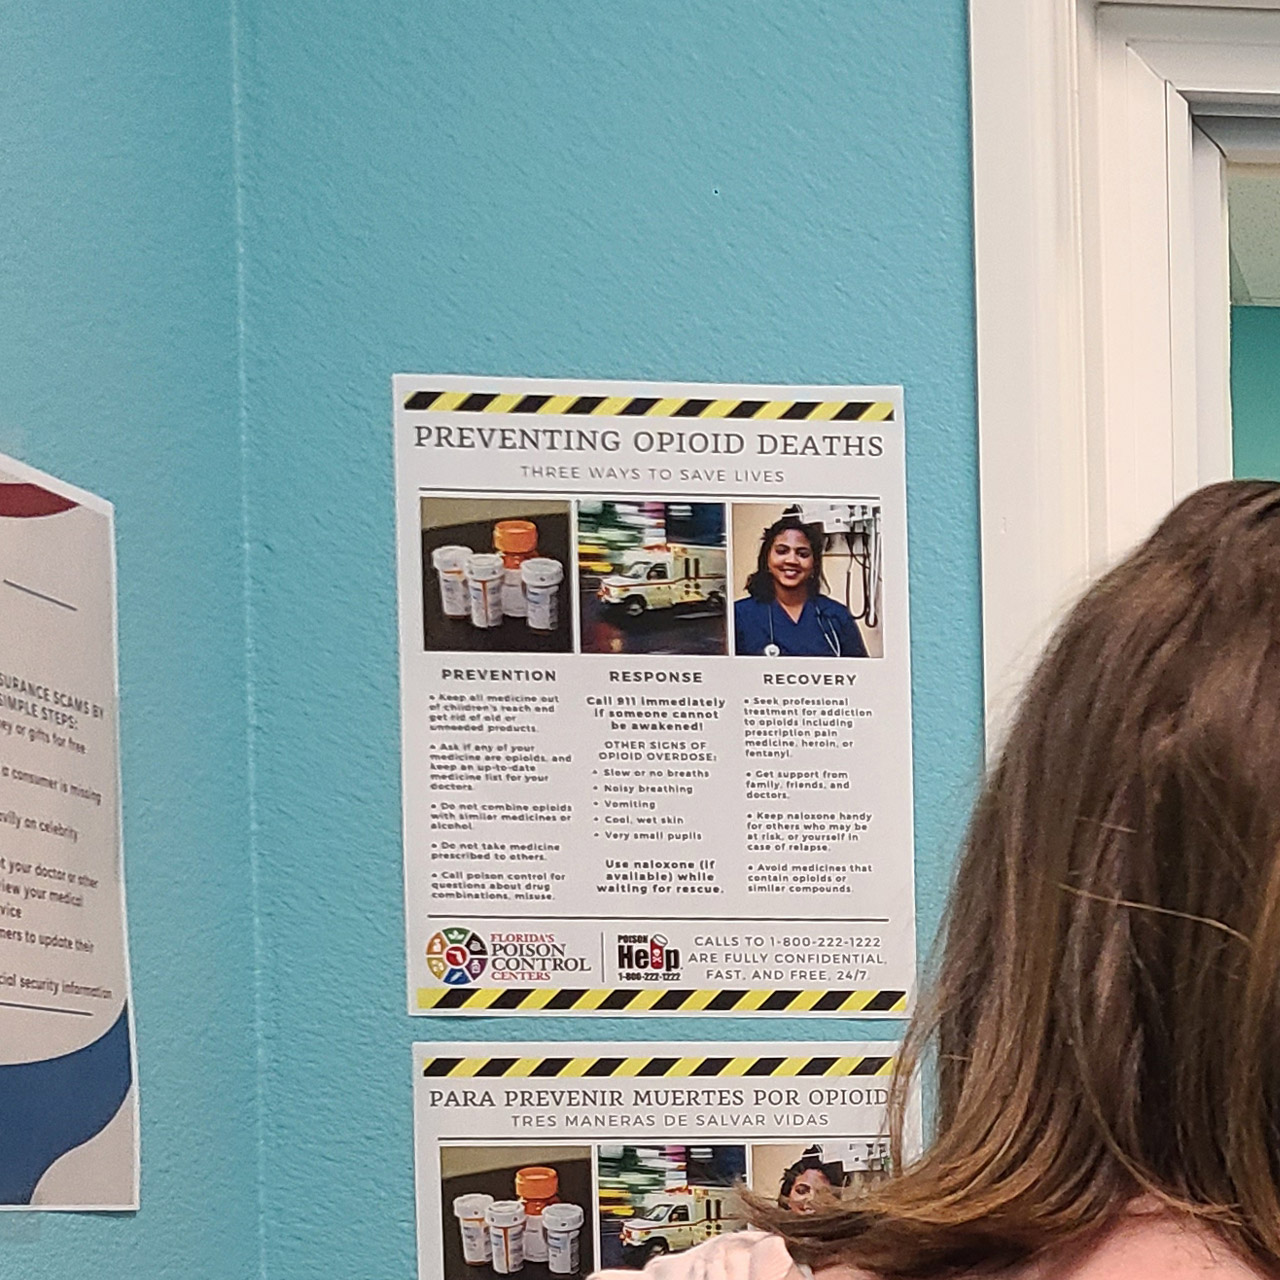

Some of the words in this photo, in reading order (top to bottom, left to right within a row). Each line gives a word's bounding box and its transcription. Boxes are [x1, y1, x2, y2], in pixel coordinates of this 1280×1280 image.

[414, 426, 620, 452] PREVENTING
[634, 431, 744, 454] OPIOID
[757, 434, 883, 457] DEATHS
[520, 465, 580, 479] THREE
[588, 467, 640, 480] WAYS
[648, 468, 672, 481] TO
[680, 469, 725, 482] SAVE
[735, 470, 784, 483] LIVES
[442, 668, 556, 682] PREVENTION
[609, 670, 702, 684] RESPONSE
[763, 673, 856, 686] RECOVERY
[54, 691, 90, 715] SCAMS
[586, 696, 612, 706] Call
[617, 697, 636, 706] 911
[641, 696, 725, 709] immediately
[594, 708, 604, 717] if
[672, 710, 718, 719] cannot
[611, 721, 626, 730] be
[632, 721, 703, 731] awakened!
[604, 740, 645, 750] OTHER
[649, 741, 686, 750] SIGNS
[690, 742, 706, 750] OF
[598, 752, 643, 761] OPIOID
[646, 752, 717, 762] OVERDOSE:
[604, 784, 635, 794] Noisy
[638, 785, 693, 795] breathing
[604, 800, 655, 810] Vomiting
[757, 812, 783, 821] Keep
[787, 812, 835, 820] naloxone
[839, 812, 872, 822] handy
[605, 859, 629, 869] Use
[634, 860, 695, 869] naloxone
[700, 860, 715, 870] (if
[9, 861, 32, 874] your
[34, 864, 66, 881] doctor
[606, 871, 673, 882] available)
[677, 872, 714, 881] while
[24, 886, 46, 899] your
[596, 883, 648, 895] waiting
[652, 884, 671, 893] for
[676, 886, 724, 894] rescue.
[25, 930, 36, 944] to
[38, 934, 74, 950] update
[490, 933, 555, 943] FLORIDA'S
[618, 935, 648, 944] POISON
[694, 936, 739, 947] CALLS
[745, 936, 764, 947] TO
[770, 937, 880, 948] 1-800-222-1222
[491, 943, 566, 957] POISON
[688, 953, 718, 963] ARE
[725, 953, 768, 964] FULLY
[774, 953, 887, 964] CONFIDENTIAL,
[491, 957, 592, 973] CONTROL
[491, 971, 551, 981] CENTERS
[706, 969, 746, 981] FAST,
[752, 970, 784, 980] AND
[790, 970, 831, 981] FREE,
[20, 976, 59, 996] security
[429, 1090, 496, 1107] PARA
[504, 1090, 624, 1107] PREVENIR
[633, 1090, 744, 1106] MUERTES
[753, 1089, 800, 1106] POR
[511, 1115, 557, 1127] TRES
[565, 1115, 655, 1127] MANERAS
[664, 1115, 687, 1127] DE
[696, 1114, 765, 1126] SALVAR
[774, 1114, 828, 1126] VIDAS
